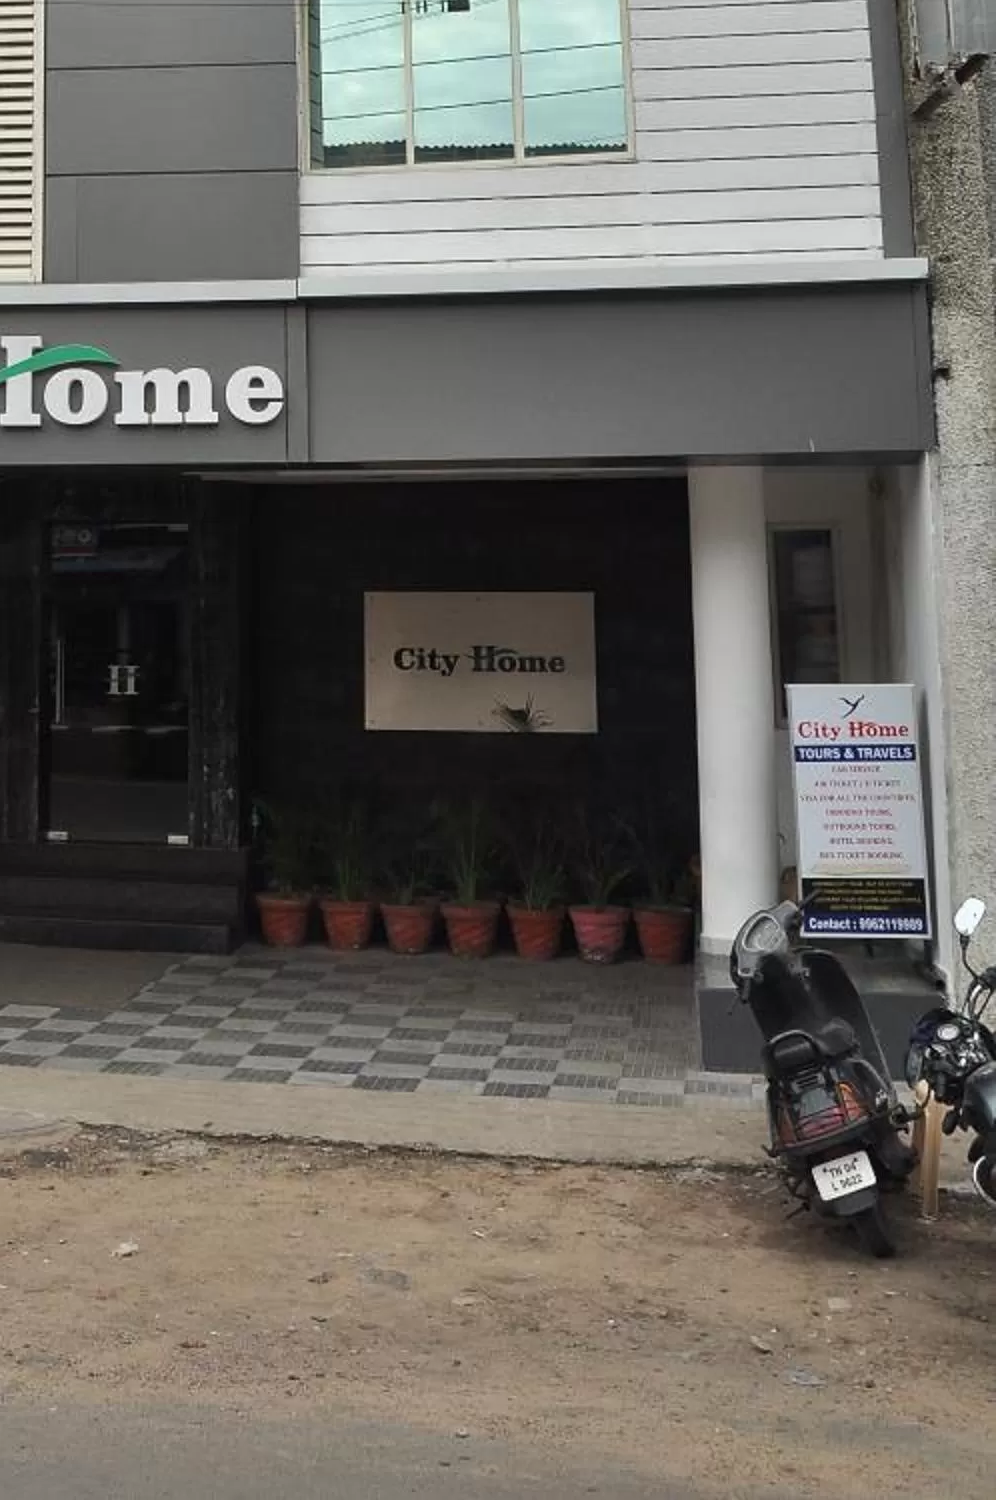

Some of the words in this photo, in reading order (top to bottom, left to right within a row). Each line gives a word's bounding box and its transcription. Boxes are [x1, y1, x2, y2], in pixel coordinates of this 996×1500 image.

[393, 647, 459, 676] City
[470, 645, 566, 673] Home
[798, 721, 841, 740] City
[848, 721, 909, 737] Home
[798, 747, 841, 759] TOURS
[844, 747, 854, 759] &
[857, 747, 913, 759] TRAVELS
[809, 917, 851, 930] Contact
